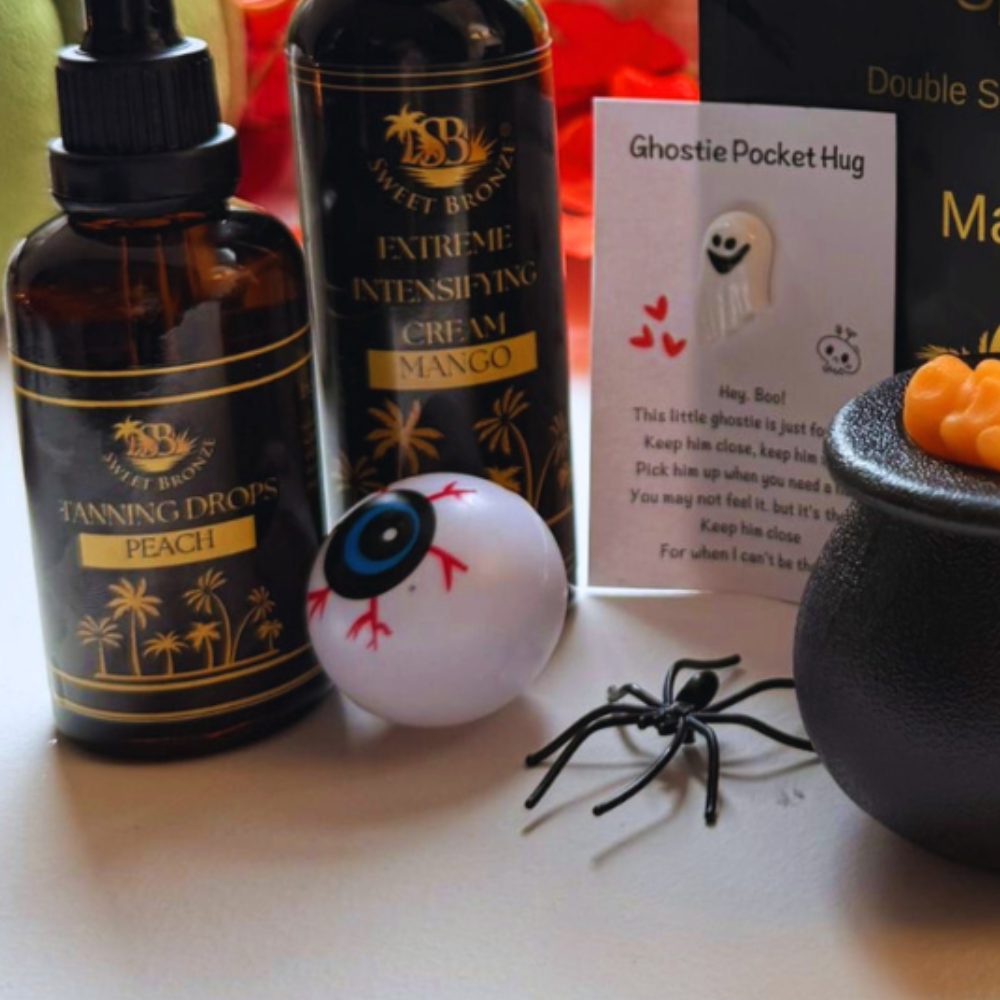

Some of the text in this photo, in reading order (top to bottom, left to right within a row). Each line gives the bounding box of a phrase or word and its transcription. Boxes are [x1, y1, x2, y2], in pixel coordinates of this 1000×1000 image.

[867, 66, 967, 105] Double
[629, 134, 866, 180] Ghostie Pocket Hug
[369, 146, 516, 215] SWEET BRONZE
[377, 225, 513, 260] EXTREME
[353, 260, 538, 303] INTENSIFYING
[402, 311, 506, 346] CREAM
[400, 344, 512, 379] MANGO
[755, 386, 786, 406] Boo!
[633, 406, 827, 437] This little ghostie is just fo
[644, 434, 683, 454] Keep
[686, 436, 712, 451] him
[716, 439, 756, 458] close,
[760, 442, 791, 464] keep
[794, 446, 818, 464] him
[635, 460, 669, 477] Pick
[672, 462, 699, 478] him
[703, 468, 721, 483] up
[724, 465, 758, 483] when
[761, 474, 785, 489] you
[788, 478, 820, 492] need
[823, 483, 832, 493] a
[60, 477, 278, 526] TANNING DROPS
[630, 488, 659, 504] You
[663, 494, 693, 509] may
[697, 492, 722, 506] not
[727, 492, 752, 509] feel
[773, 498, 794, 516] but
[798, 503, 820, 519] it's
[126, 529, 215, 558] PEACH
[700, 517, 801, 543] Keep him close
[660, 543, 687, 559] For
[691, 545, 729, 561] when
[741, 551, 774, 566] can't
[778, 552, 793, 570] be
